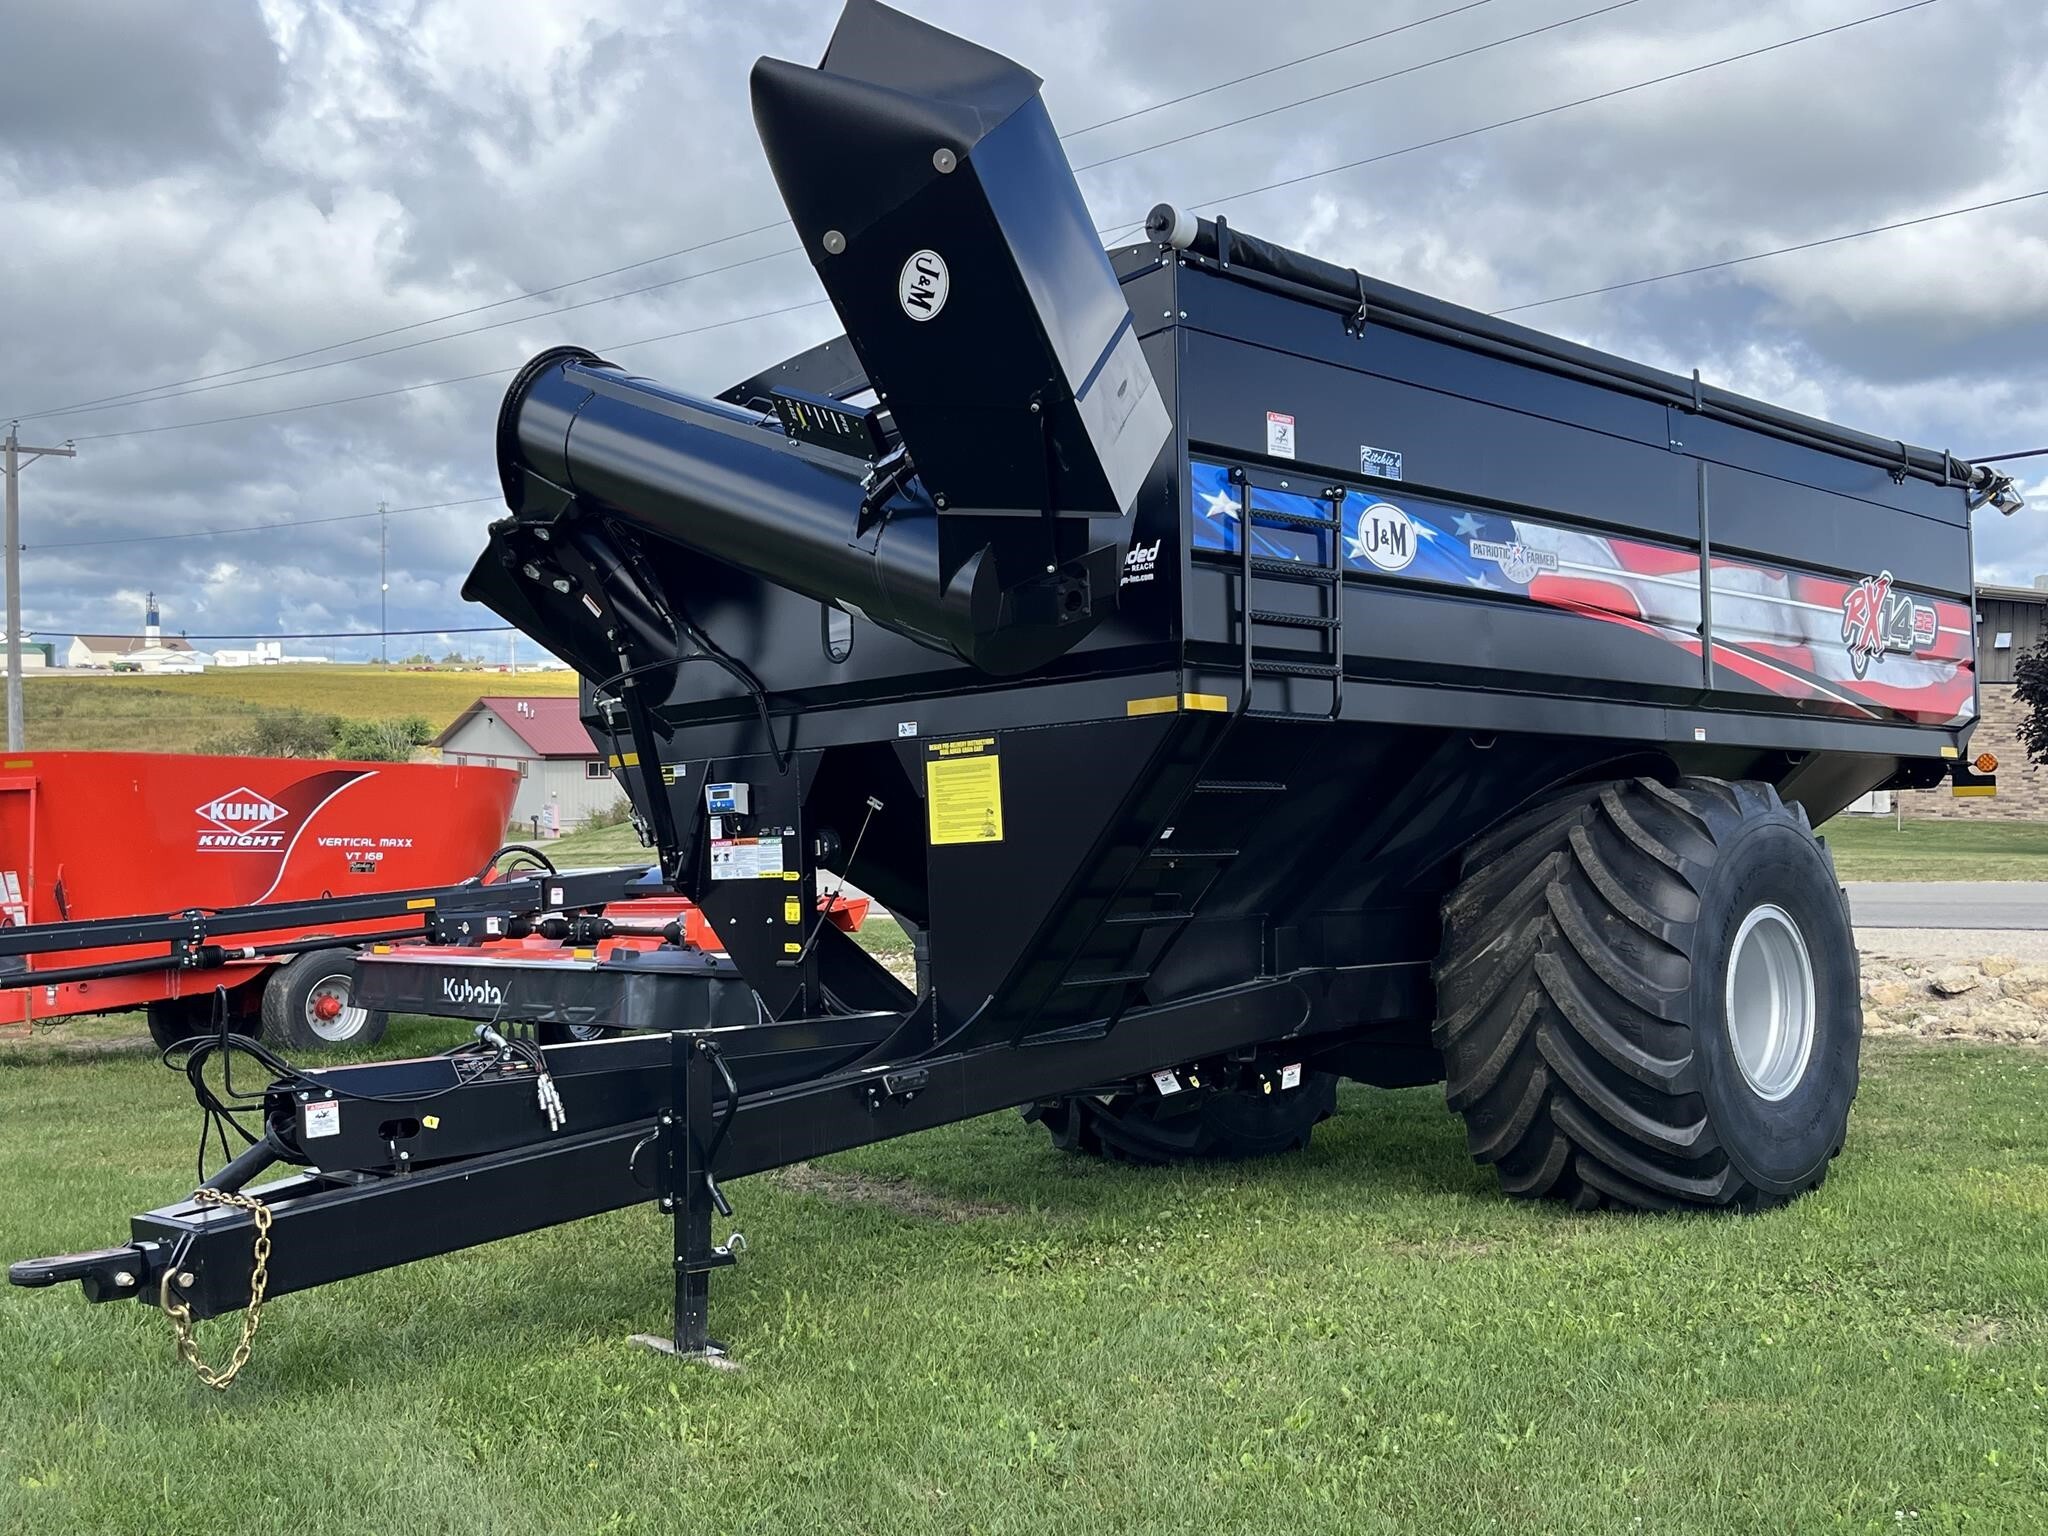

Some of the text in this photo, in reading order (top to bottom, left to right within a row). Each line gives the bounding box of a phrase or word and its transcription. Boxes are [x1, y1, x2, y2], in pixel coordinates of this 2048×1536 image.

[907, 257, 940, 312] J&M
[1364, 518, 1407, 557] J&M
[1125, 539, 1161, 565] ded
[1473, 542, 1555, 567] PATRIOTIC FARMER
[1131, 562, 1155, 571] REACH
[210, 802, 275, 821] KUHN
[198, 835, 283, 847] KNIGHT
[317, 837, 414, 848] VERTICAL MAXX
[345, 852, 384, 861] VT 168
[443, 978, 503, 1004] Kubota
